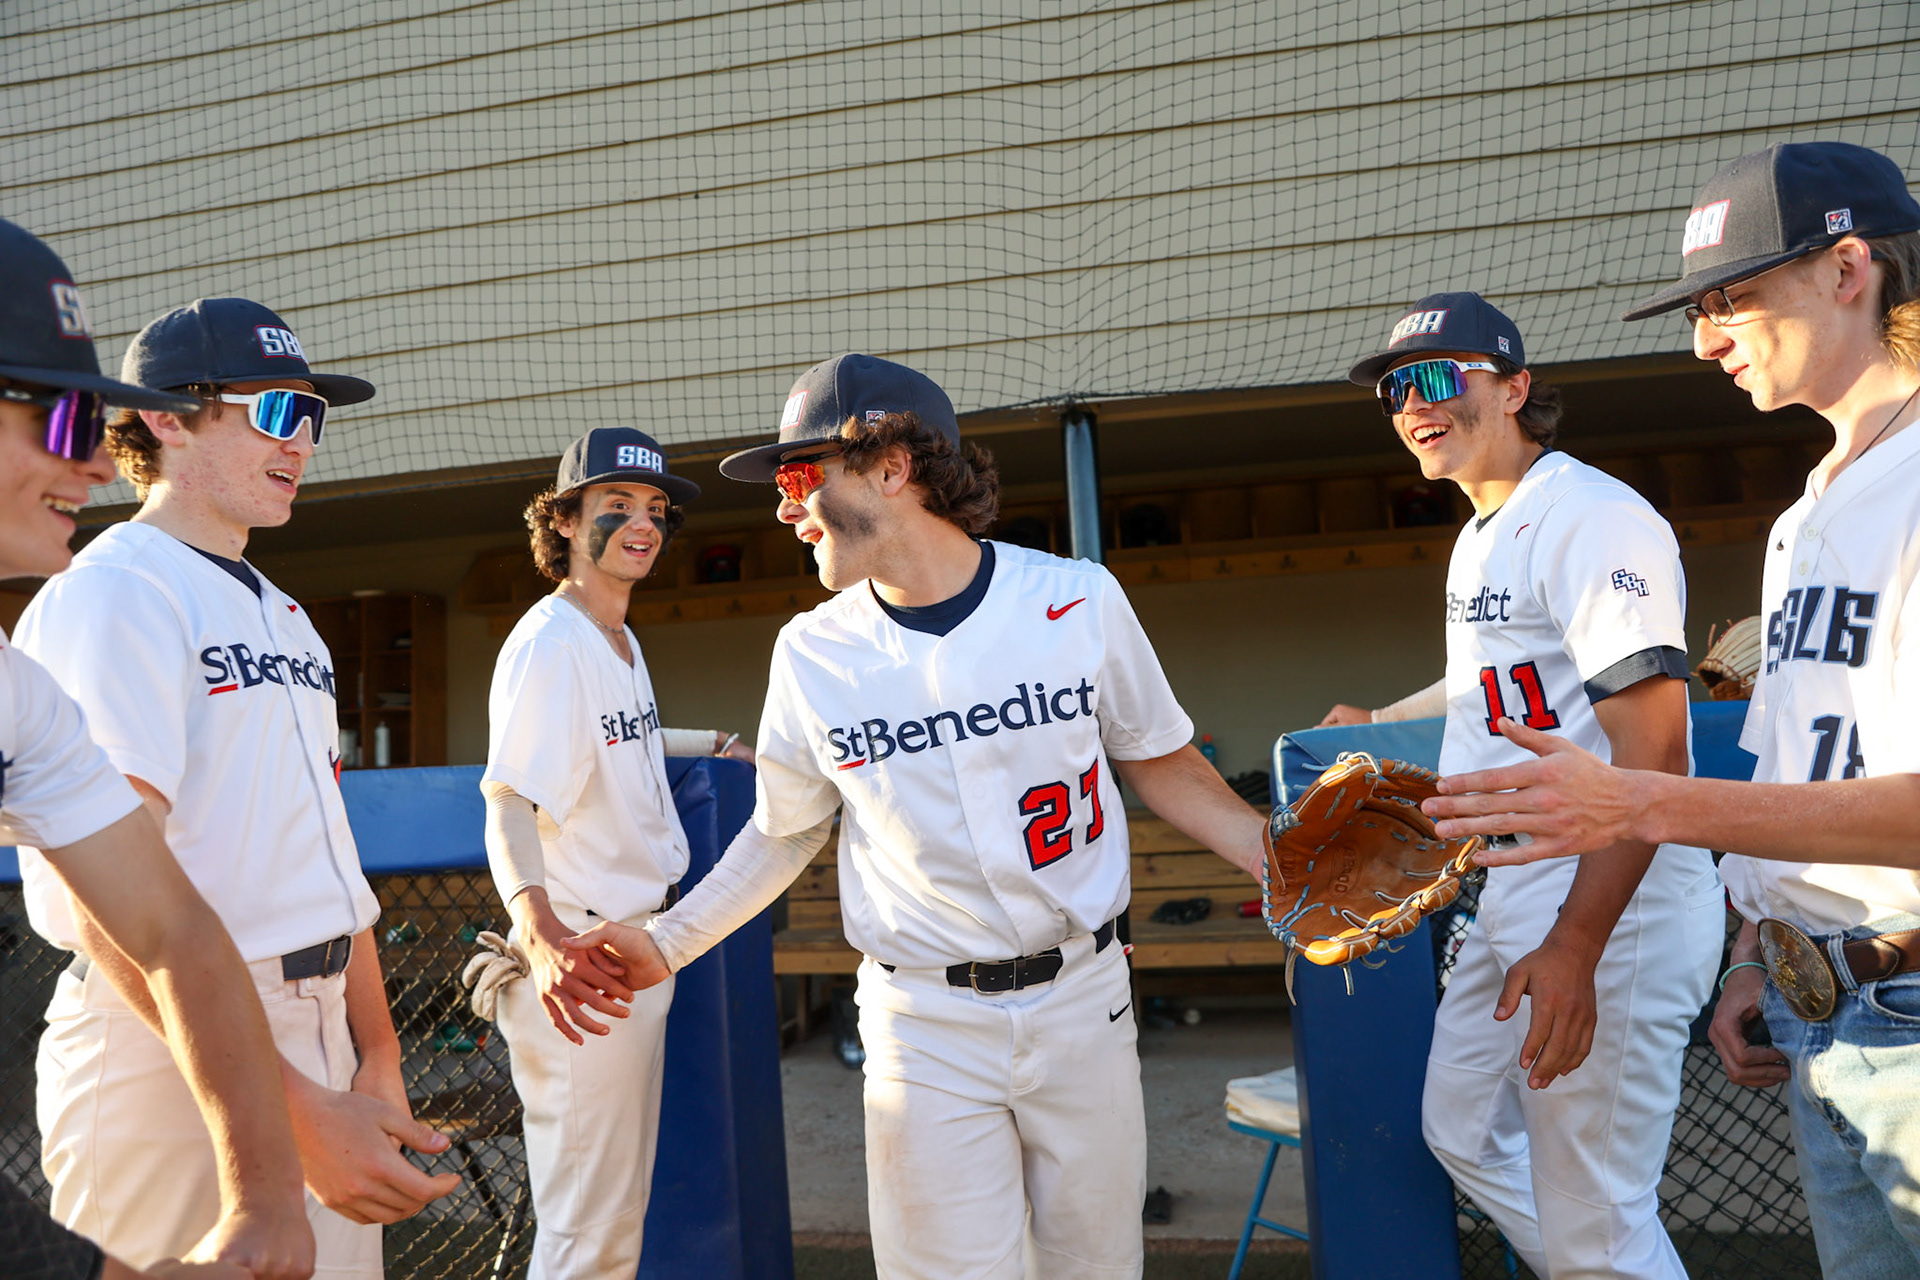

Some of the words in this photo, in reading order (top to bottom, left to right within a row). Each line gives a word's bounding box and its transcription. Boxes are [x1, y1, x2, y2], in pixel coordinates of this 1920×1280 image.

[254, 324, 309, 366] SB
[1388, 308, 1450, 350] SBA
[615, 443, 663, 474] SBA
[1611, 568, 1650, 597] SBA
[1479, 660, 1561, 737] 11
[1018, 758, 1104, 872] 27
